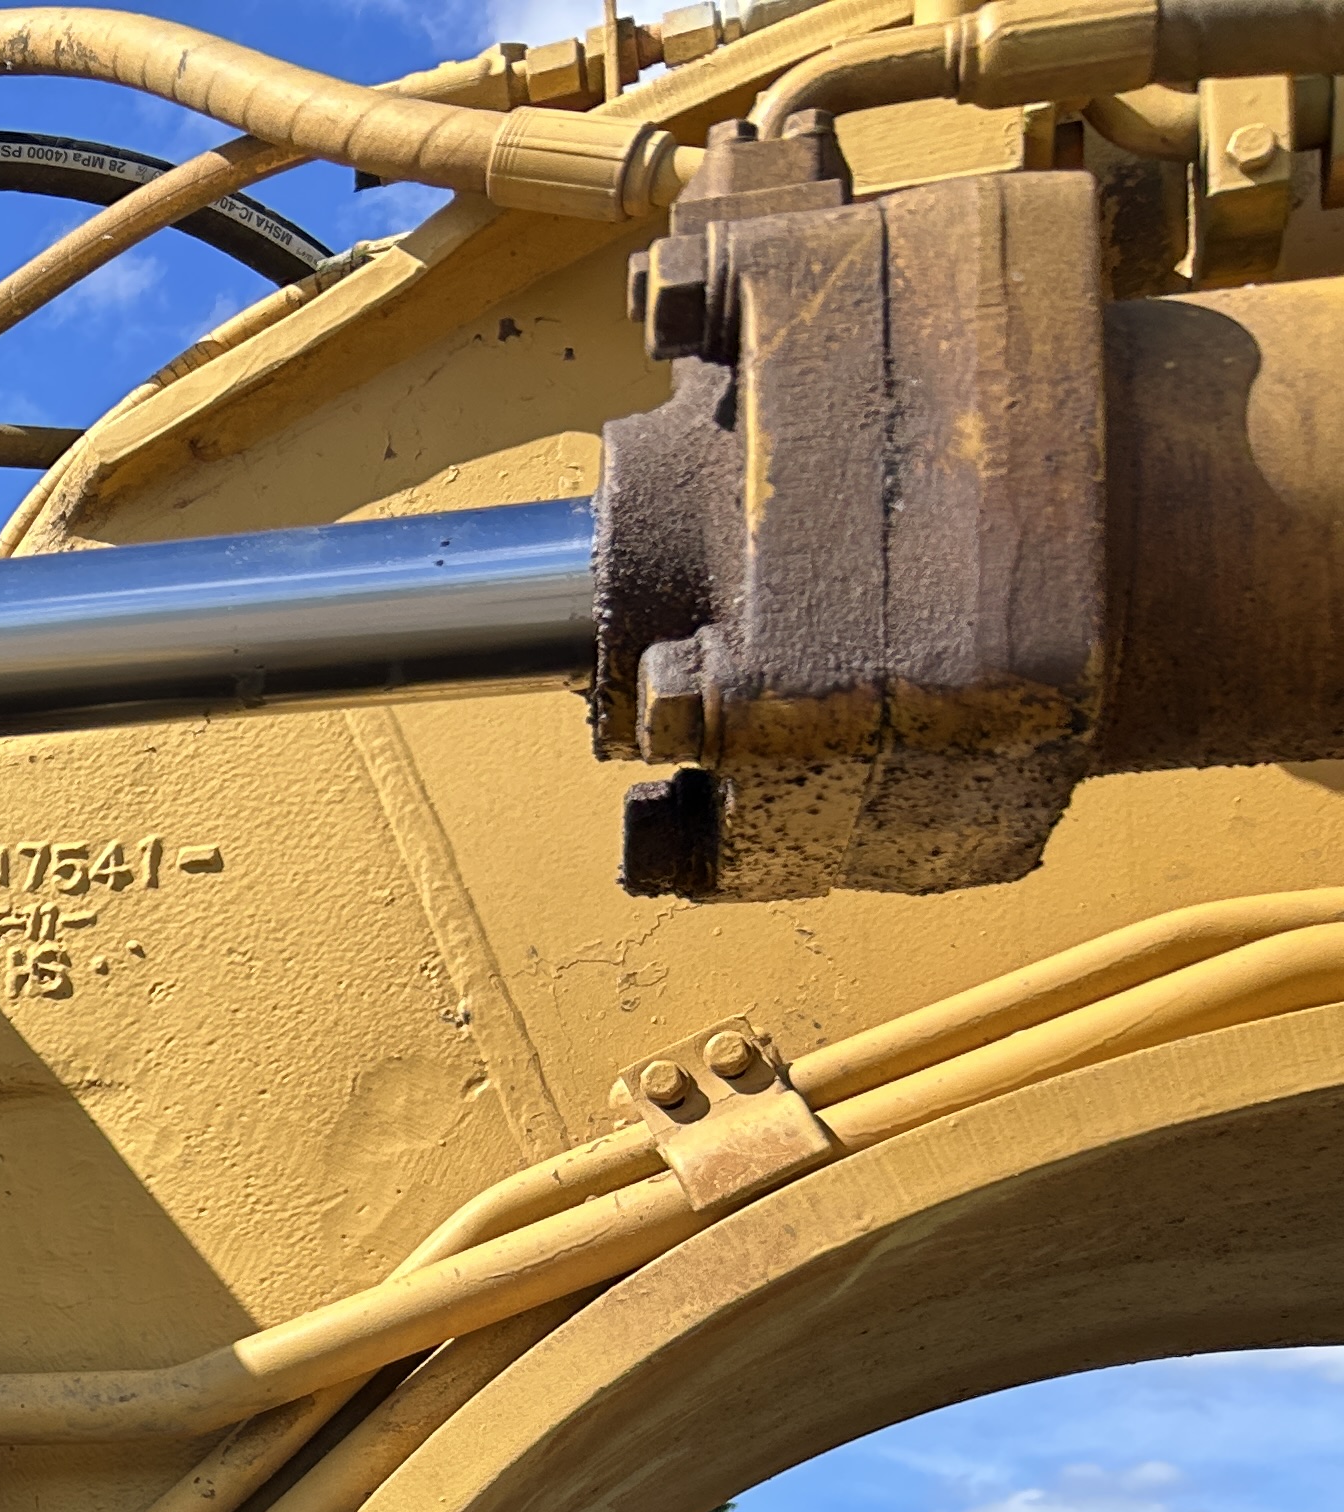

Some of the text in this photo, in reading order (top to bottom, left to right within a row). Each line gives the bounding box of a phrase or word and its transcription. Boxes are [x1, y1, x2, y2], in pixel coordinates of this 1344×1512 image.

[27, 146, 68, 163] (4000
[73, 155, 105, 169] MPa
[108, 160, 127, 174] 28
[256, 211, 293, 246] MSHA
